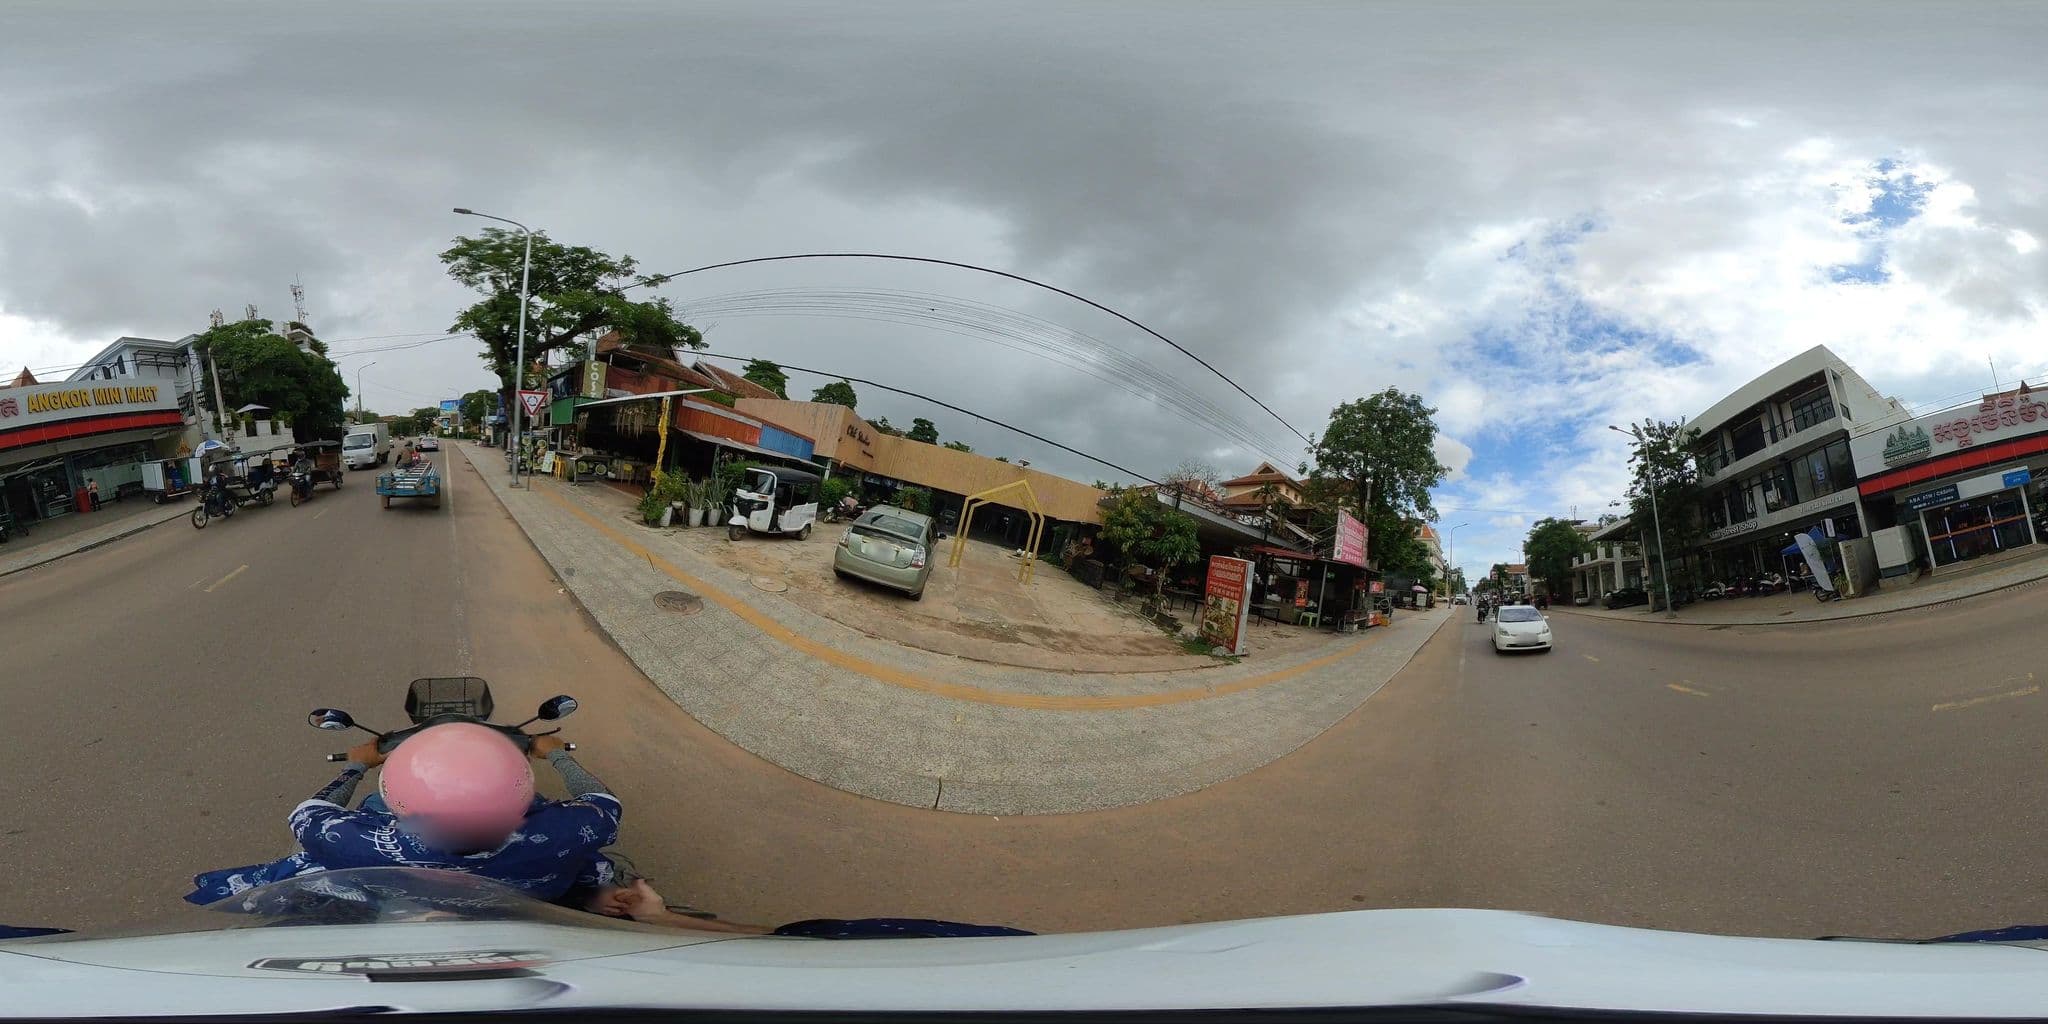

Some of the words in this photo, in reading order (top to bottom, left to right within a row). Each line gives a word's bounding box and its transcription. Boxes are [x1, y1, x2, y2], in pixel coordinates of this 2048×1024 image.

[27, 387, 92, 414] ANGKOR
[92, 386, 124, 406] MINI
[125, 384, 158, 404] MART
